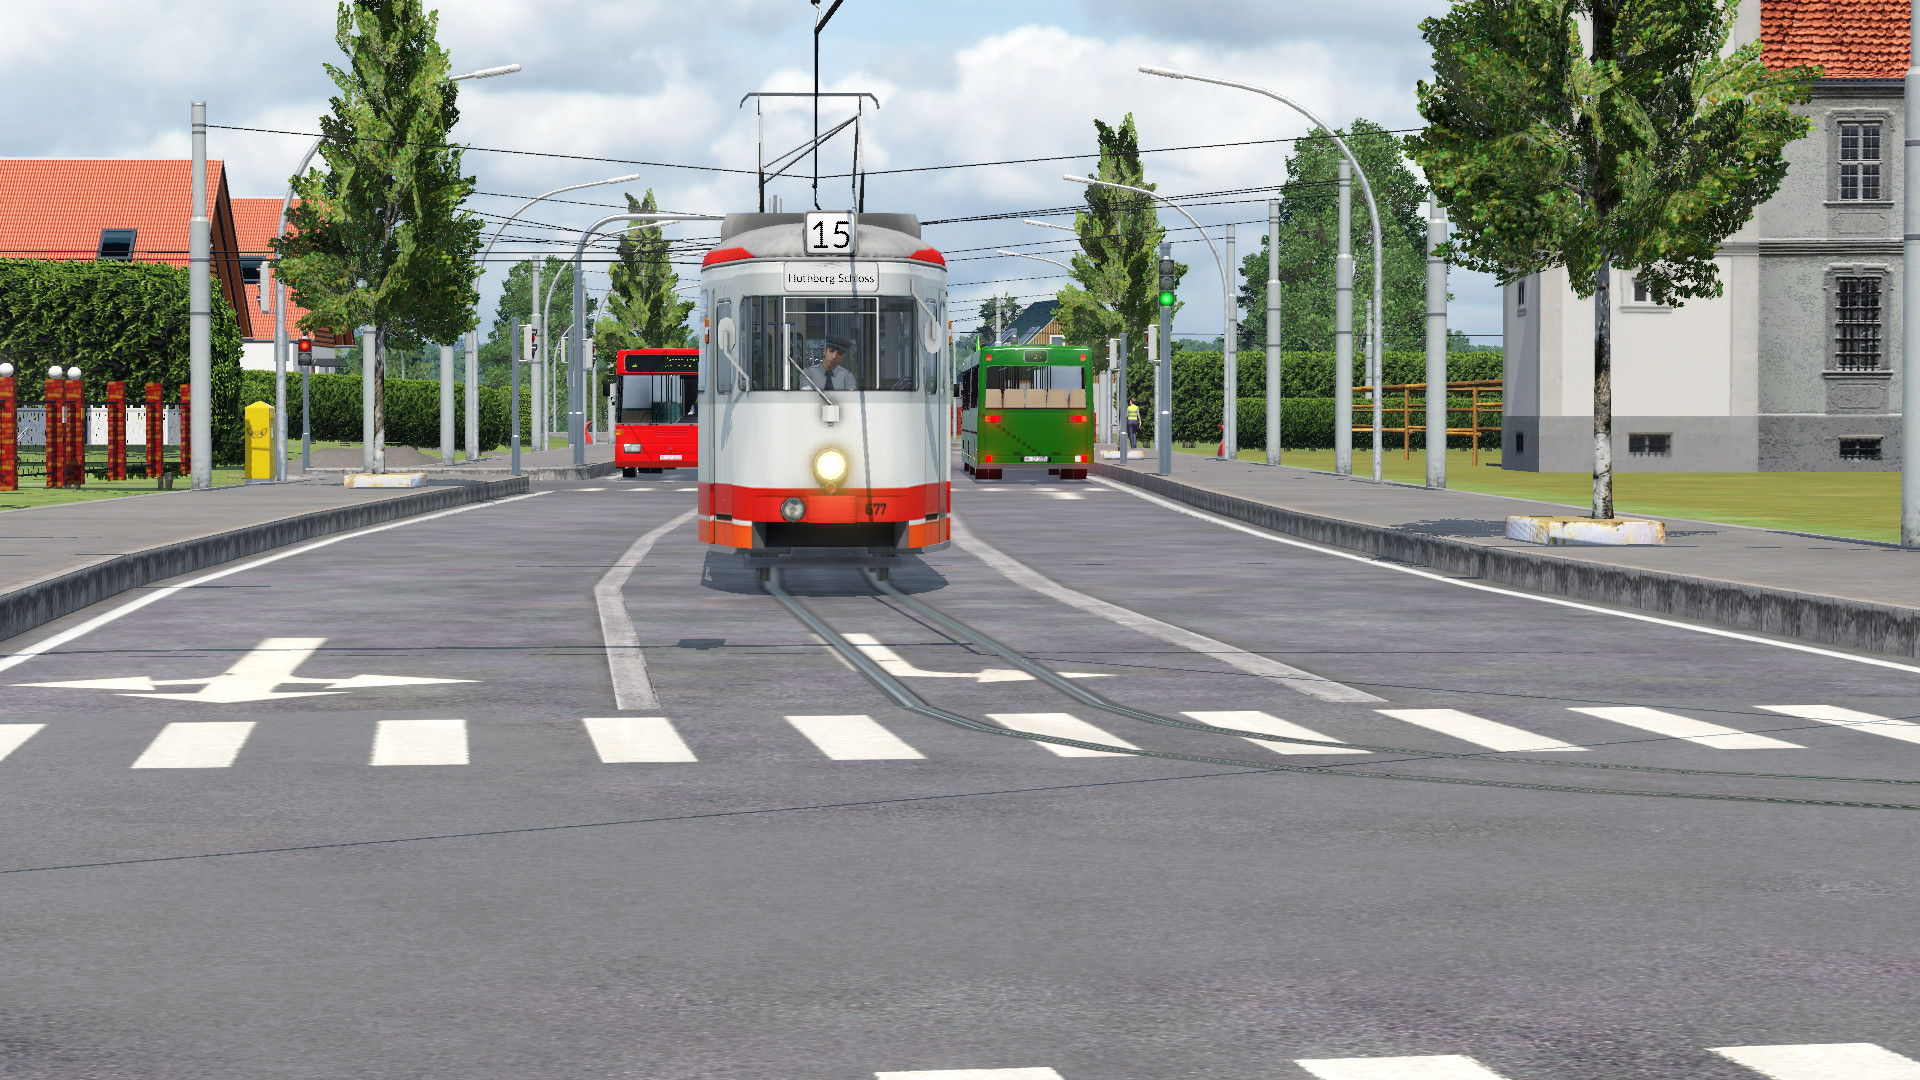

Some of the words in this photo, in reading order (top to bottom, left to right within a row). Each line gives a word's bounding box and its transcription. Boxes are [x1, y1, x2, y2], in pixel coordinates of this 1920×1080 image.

[812, 220, 850, 249] 15
[838, 273, 875, 283] Schloss
[865, 503, 887, 516] 677
